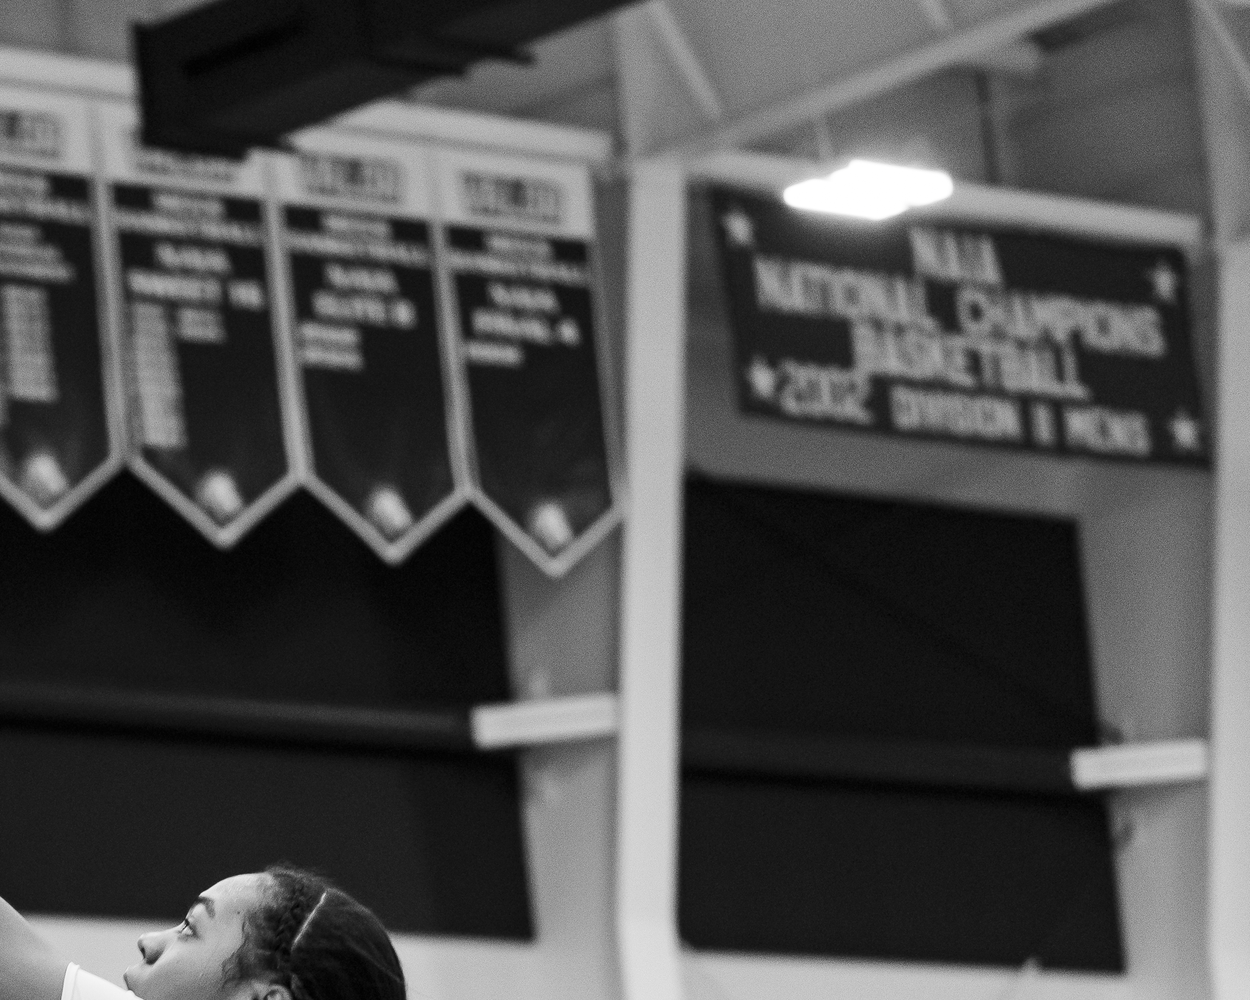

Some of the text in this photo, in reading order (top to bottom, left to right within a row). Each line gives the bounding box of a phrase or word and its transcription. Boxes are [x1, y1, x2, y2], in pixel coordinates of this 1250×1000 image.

[909, 226, 1004, 288] NAIA
[753, 253, 1165, 359] NATIONAL CHAMPIONS
[780, 360, 874, 425] 2002
[890, 385, 1023, 442] DIVISION
[851, 320, 1092, 401] BASKETBALL
